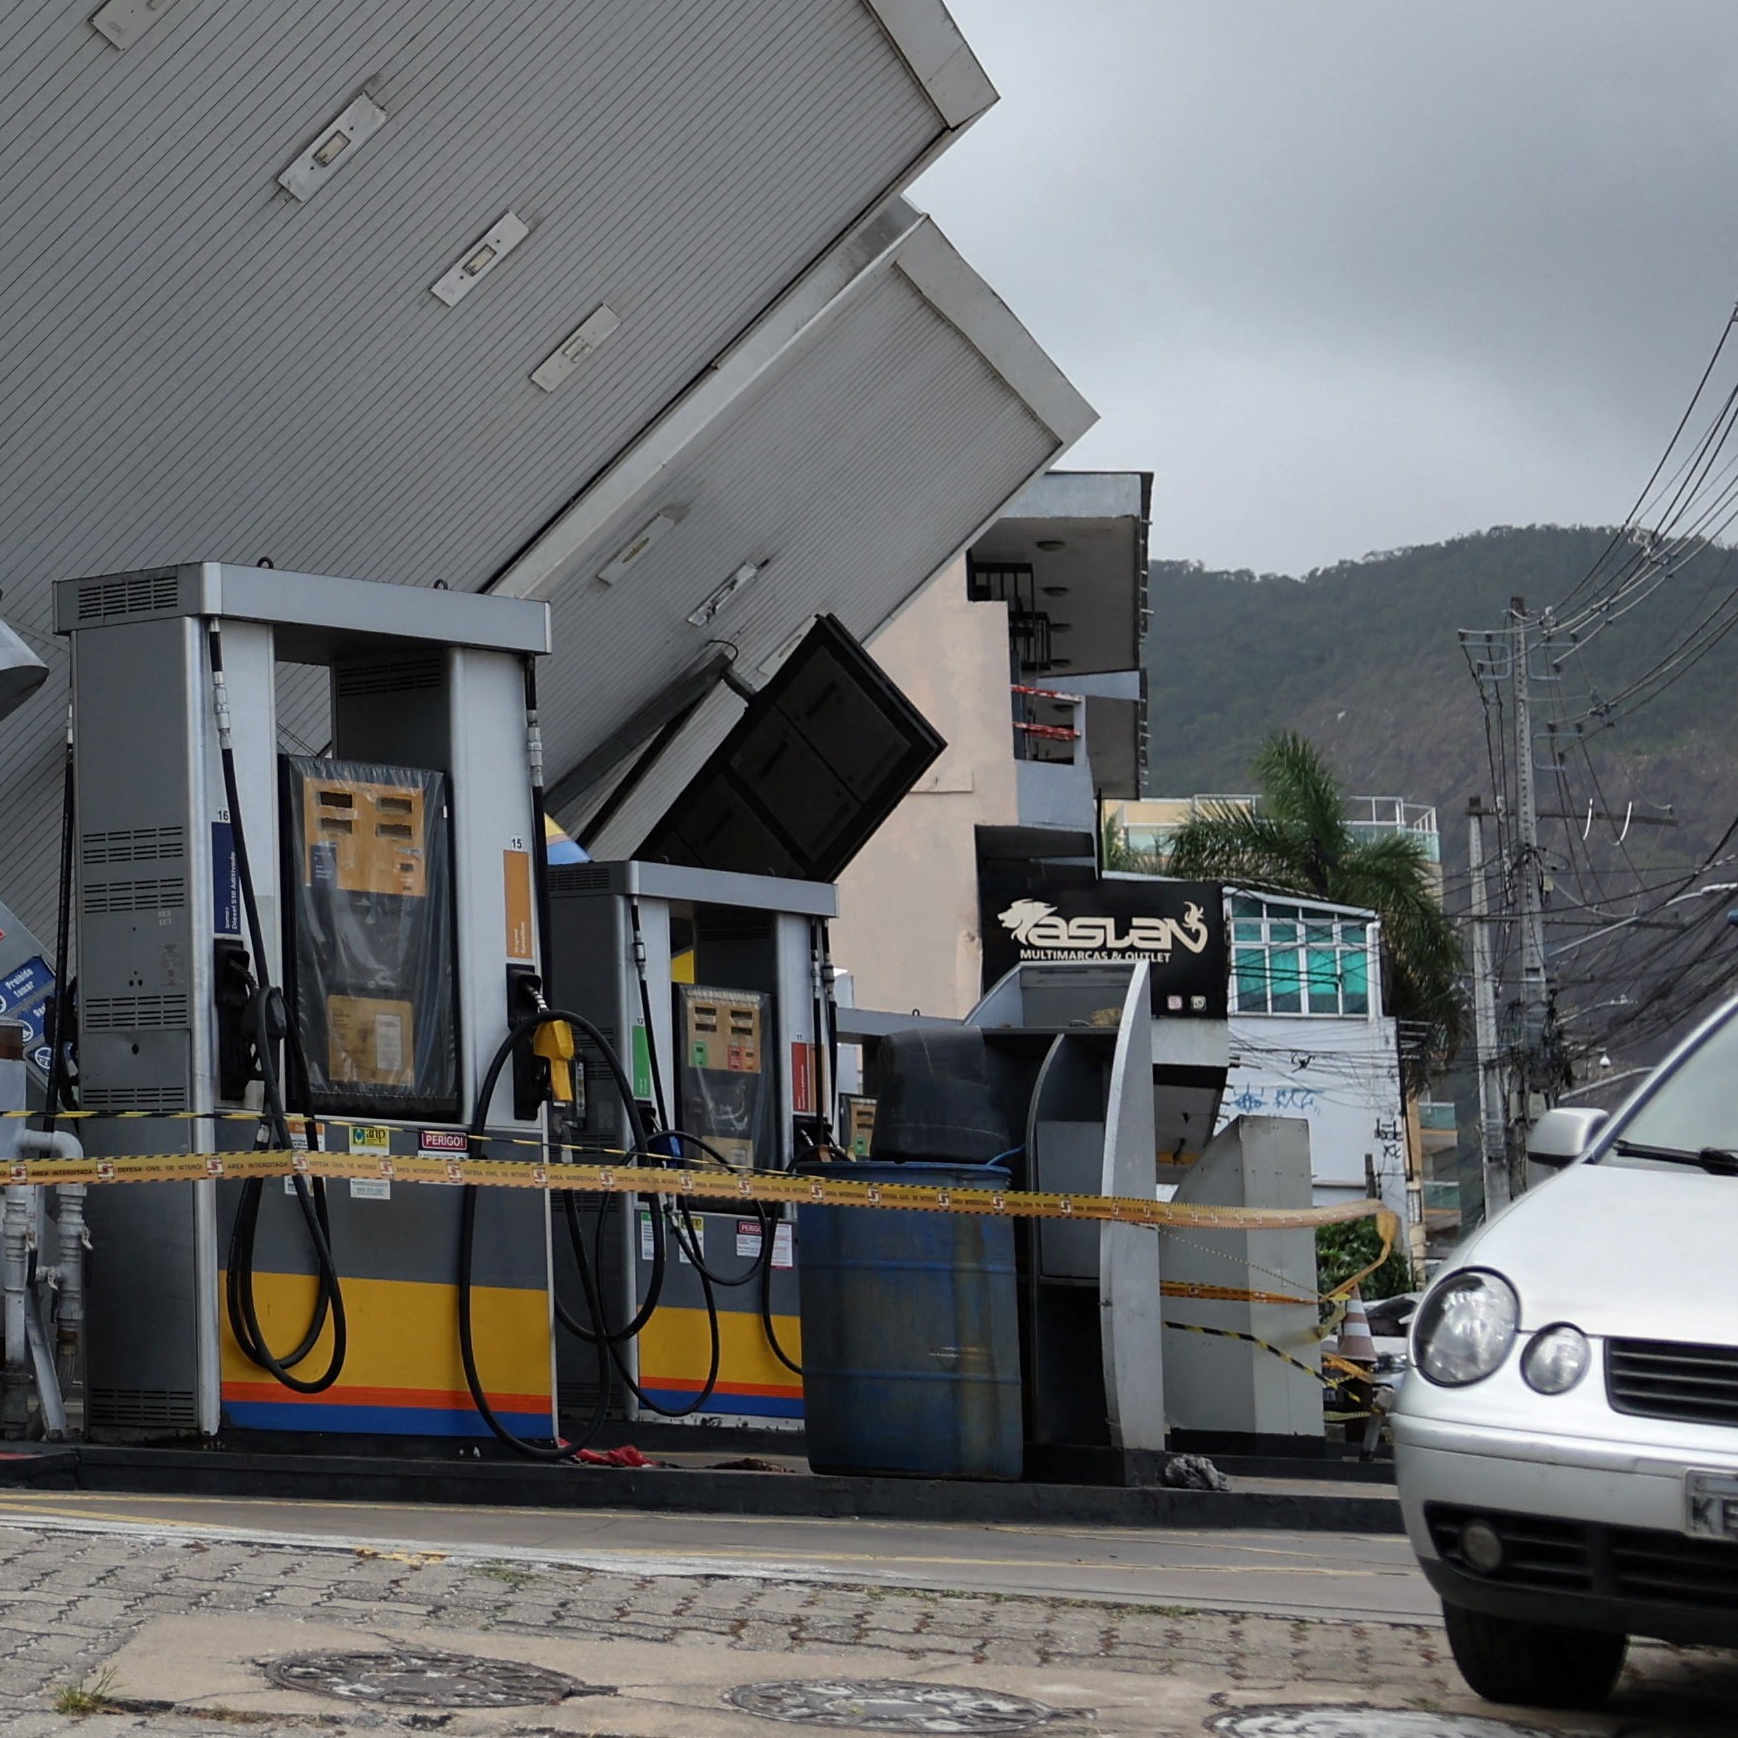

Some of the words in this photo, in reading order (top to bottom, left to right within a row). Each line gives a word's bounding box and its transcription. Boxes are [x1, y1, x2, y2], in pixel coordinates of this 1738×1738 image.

[217, 810, 229, 821] 16
[511, 838, 523, 849] 15
[1019, 949, 1109, 961] MULTIMARCAS
[1110, 950, 1123, 961] &
[1124, 950, 1172, 963] OUTLET
[365, 1127, 386, 1143] anp
[425, 1134, 465, 1147] PERIGO!
